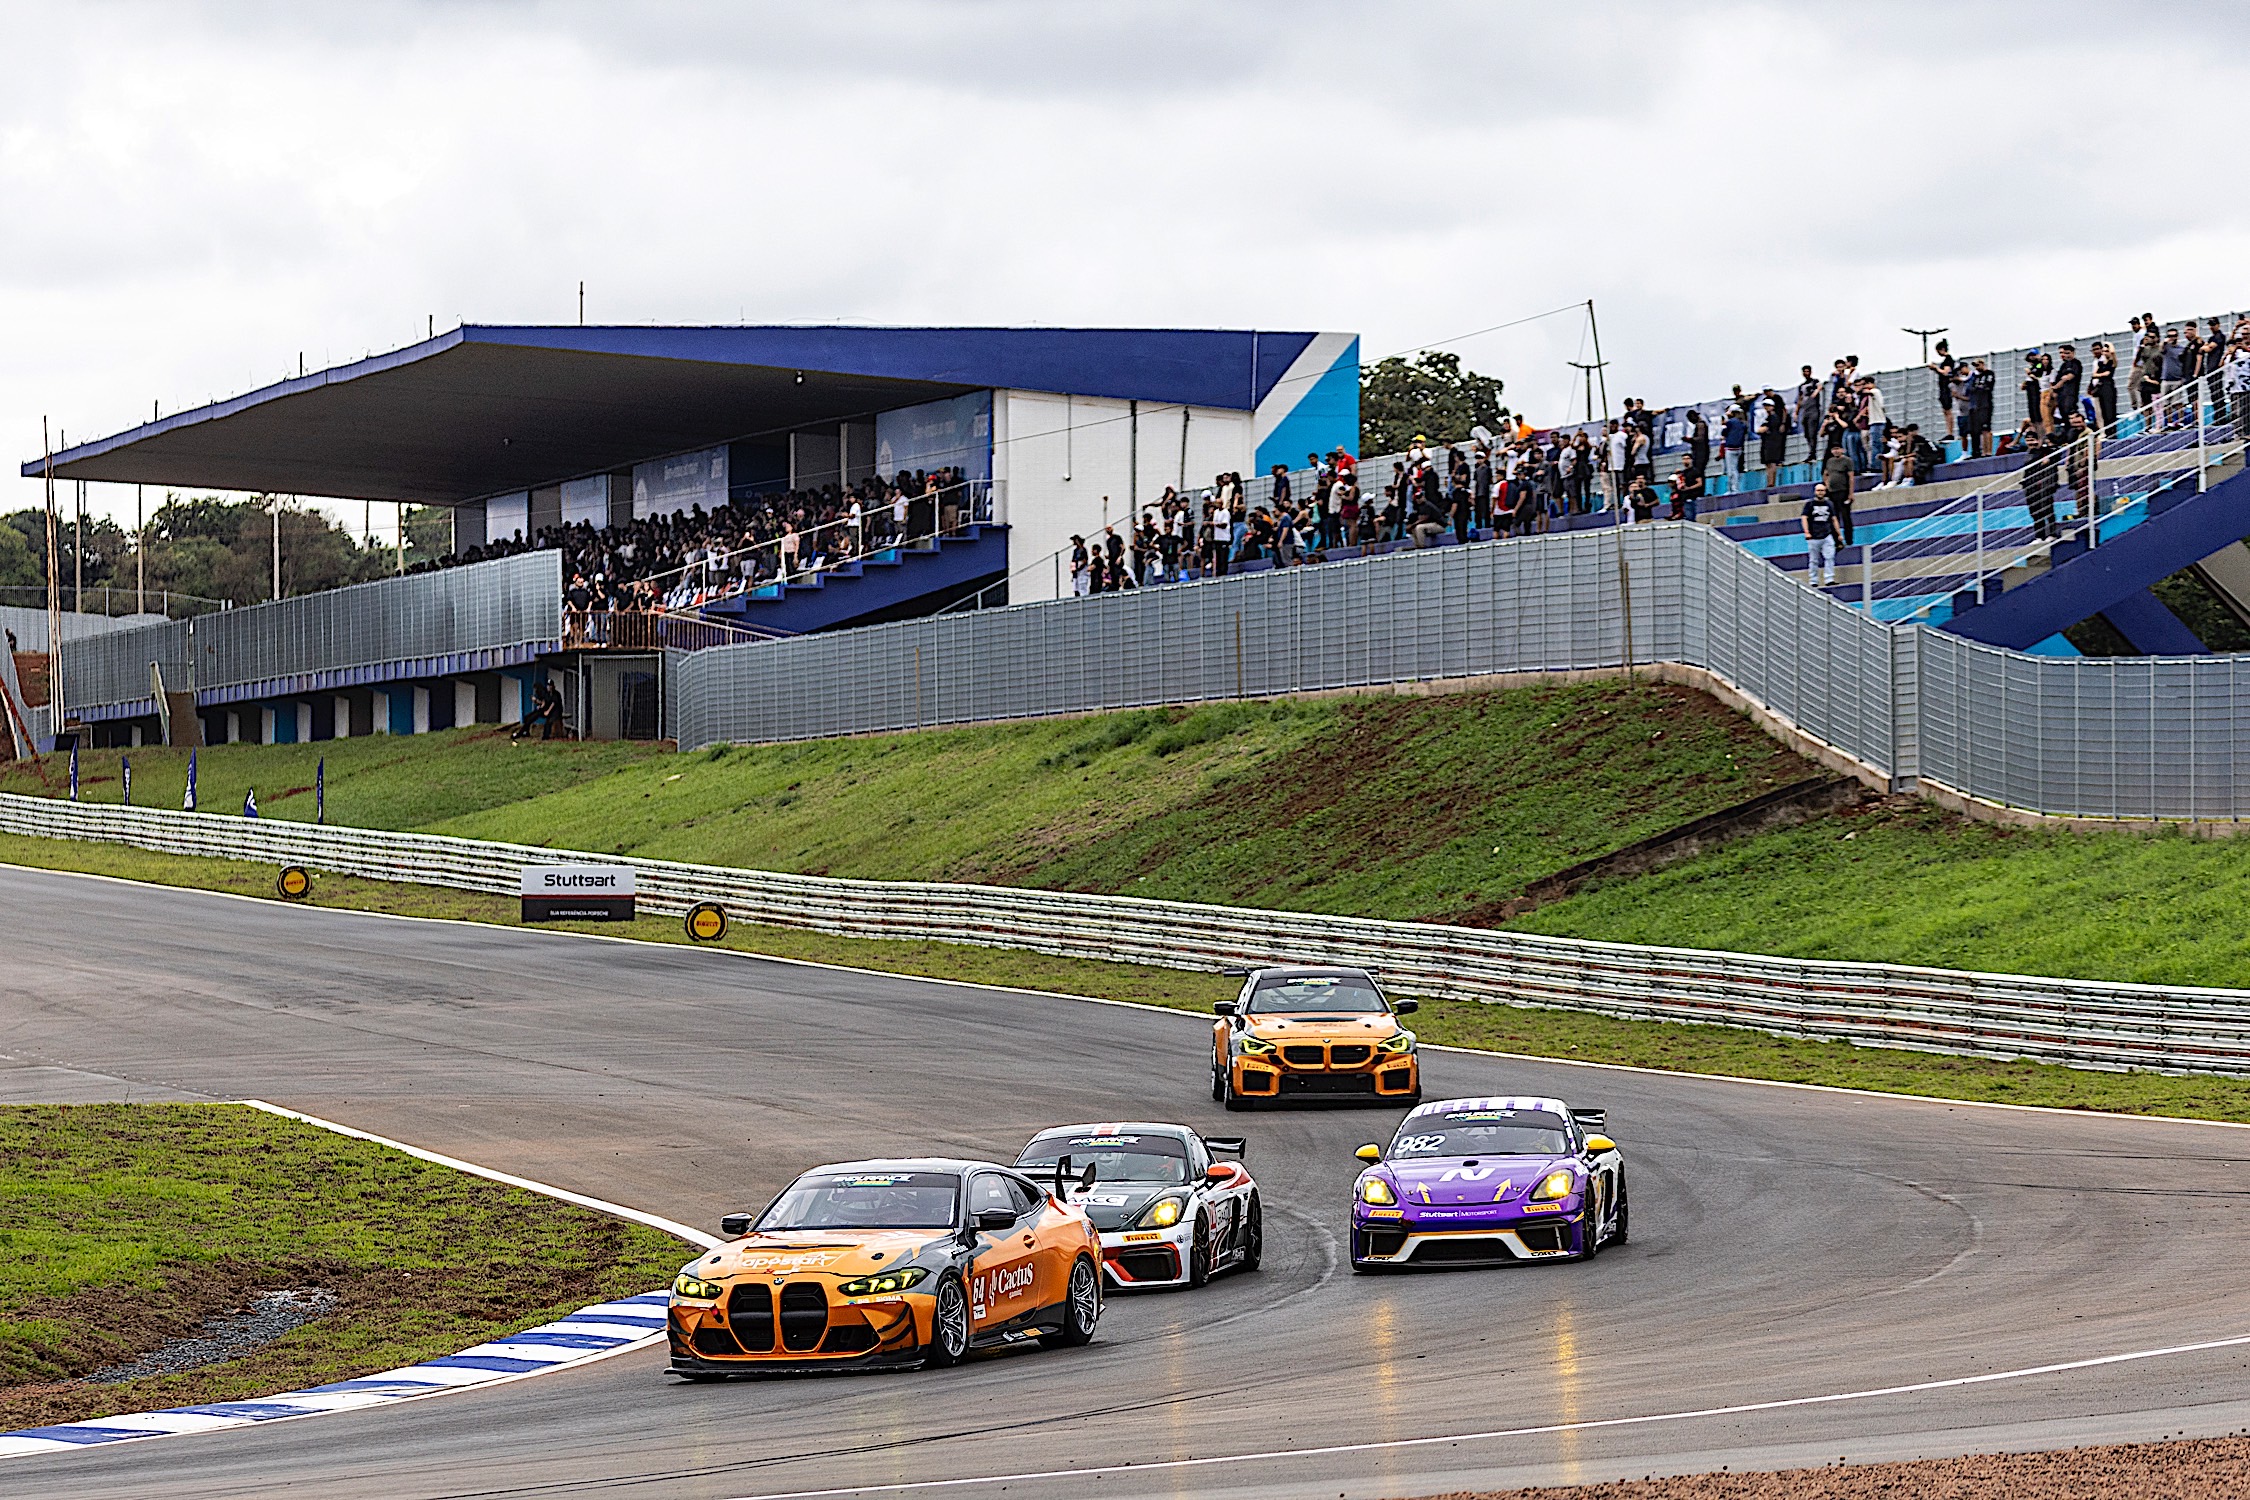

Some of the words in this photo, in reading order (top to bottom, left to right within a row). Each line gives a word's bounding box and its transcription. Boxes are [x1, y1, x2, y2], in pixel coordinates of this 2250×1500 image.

[544, 874, 616, 886] Stuttgart
[1394, 1135, 1446, 1153] 982
[1126, 1233, 1159, 1241] PIRELLI
[998, 1262, 1034, 1294] Cactus
[972, 1276, 985, 1304] 64
